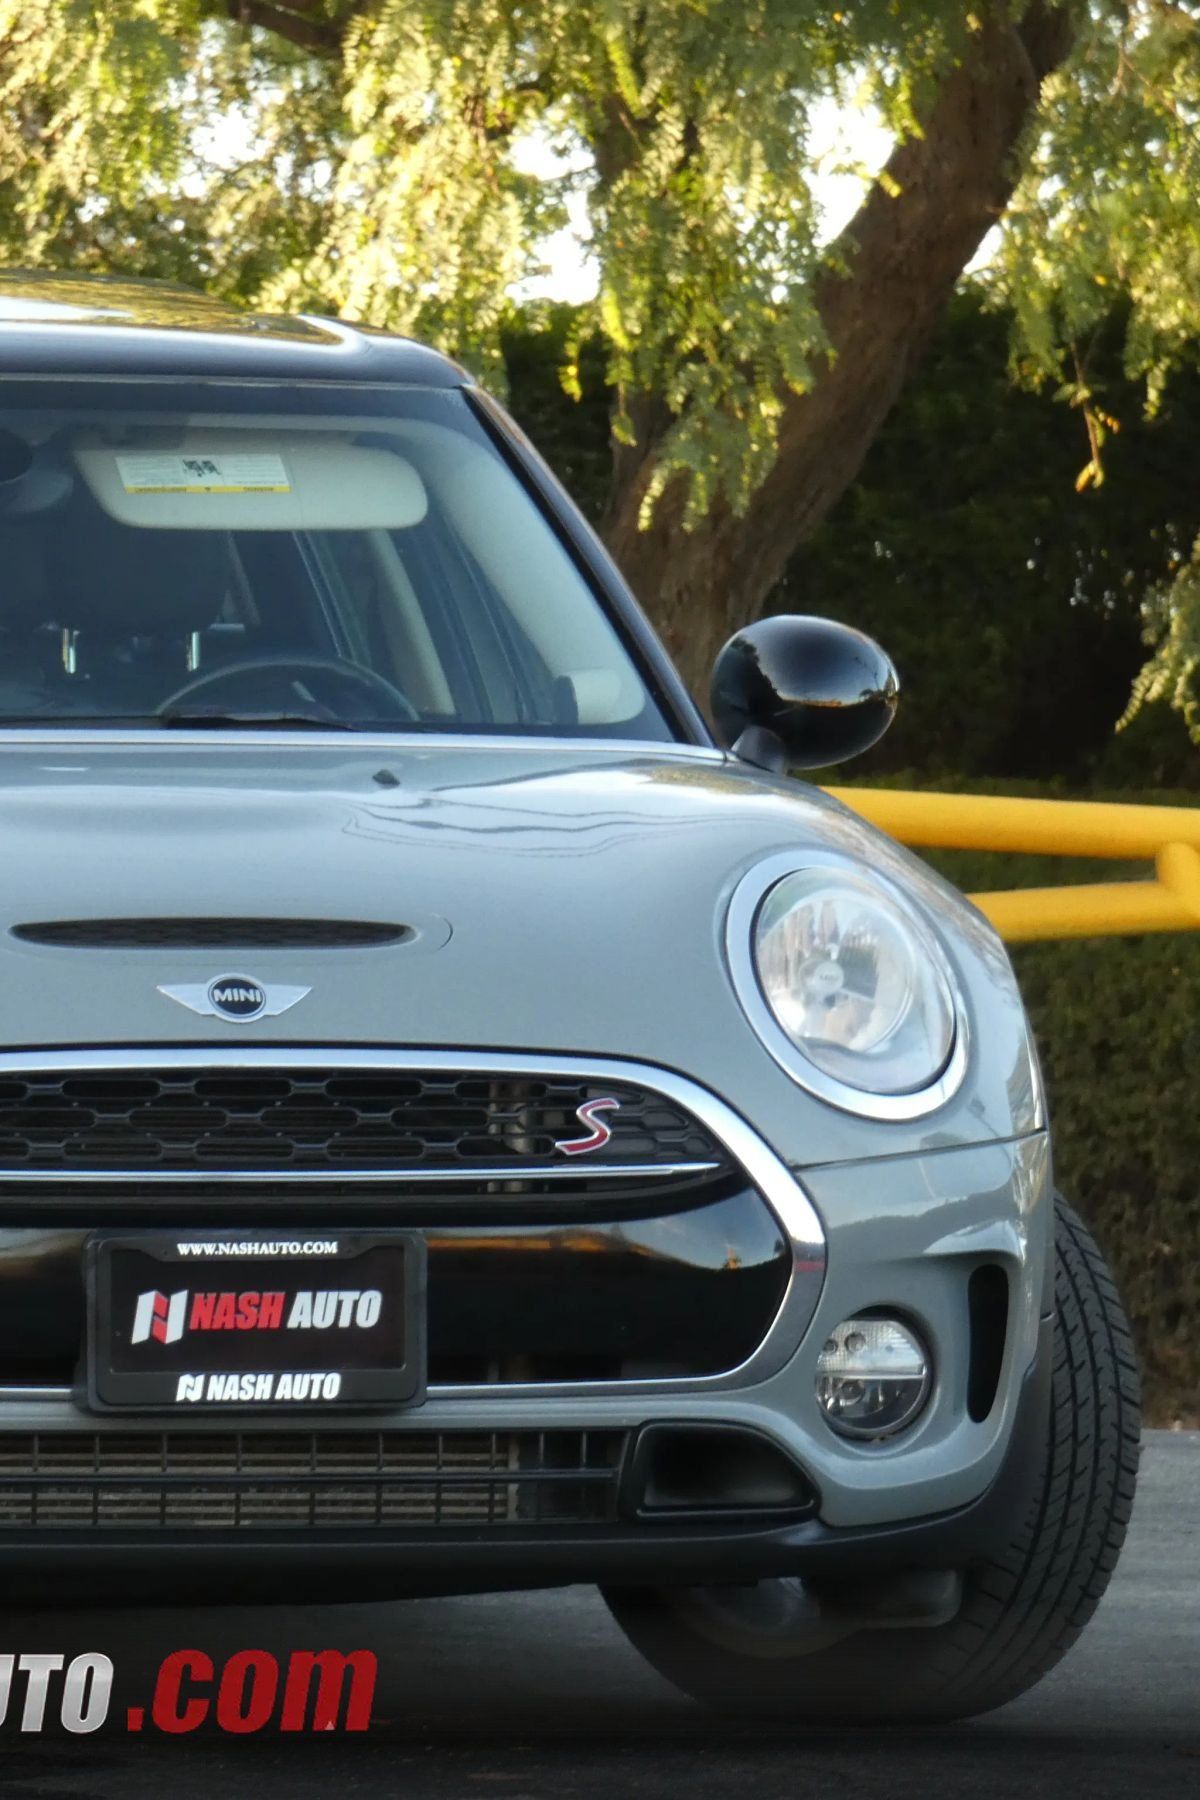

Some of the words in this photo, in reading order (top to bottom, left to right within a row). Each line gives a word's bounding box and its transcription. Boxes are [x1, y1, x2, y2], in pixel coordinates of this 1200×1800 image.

[213, 988, 262, 1003] MINI
[555, 1097, 620, 1155] S
[177, 1241, 339, 1256] WWW.NASHAUTO.COM
[189, 1292, 286, 1330] NASH
[286, 1290, 383, 1329] AUTO
[206, 1374, 274, 1401] NASH
[274, 1372, 341, 1400] AUTO
